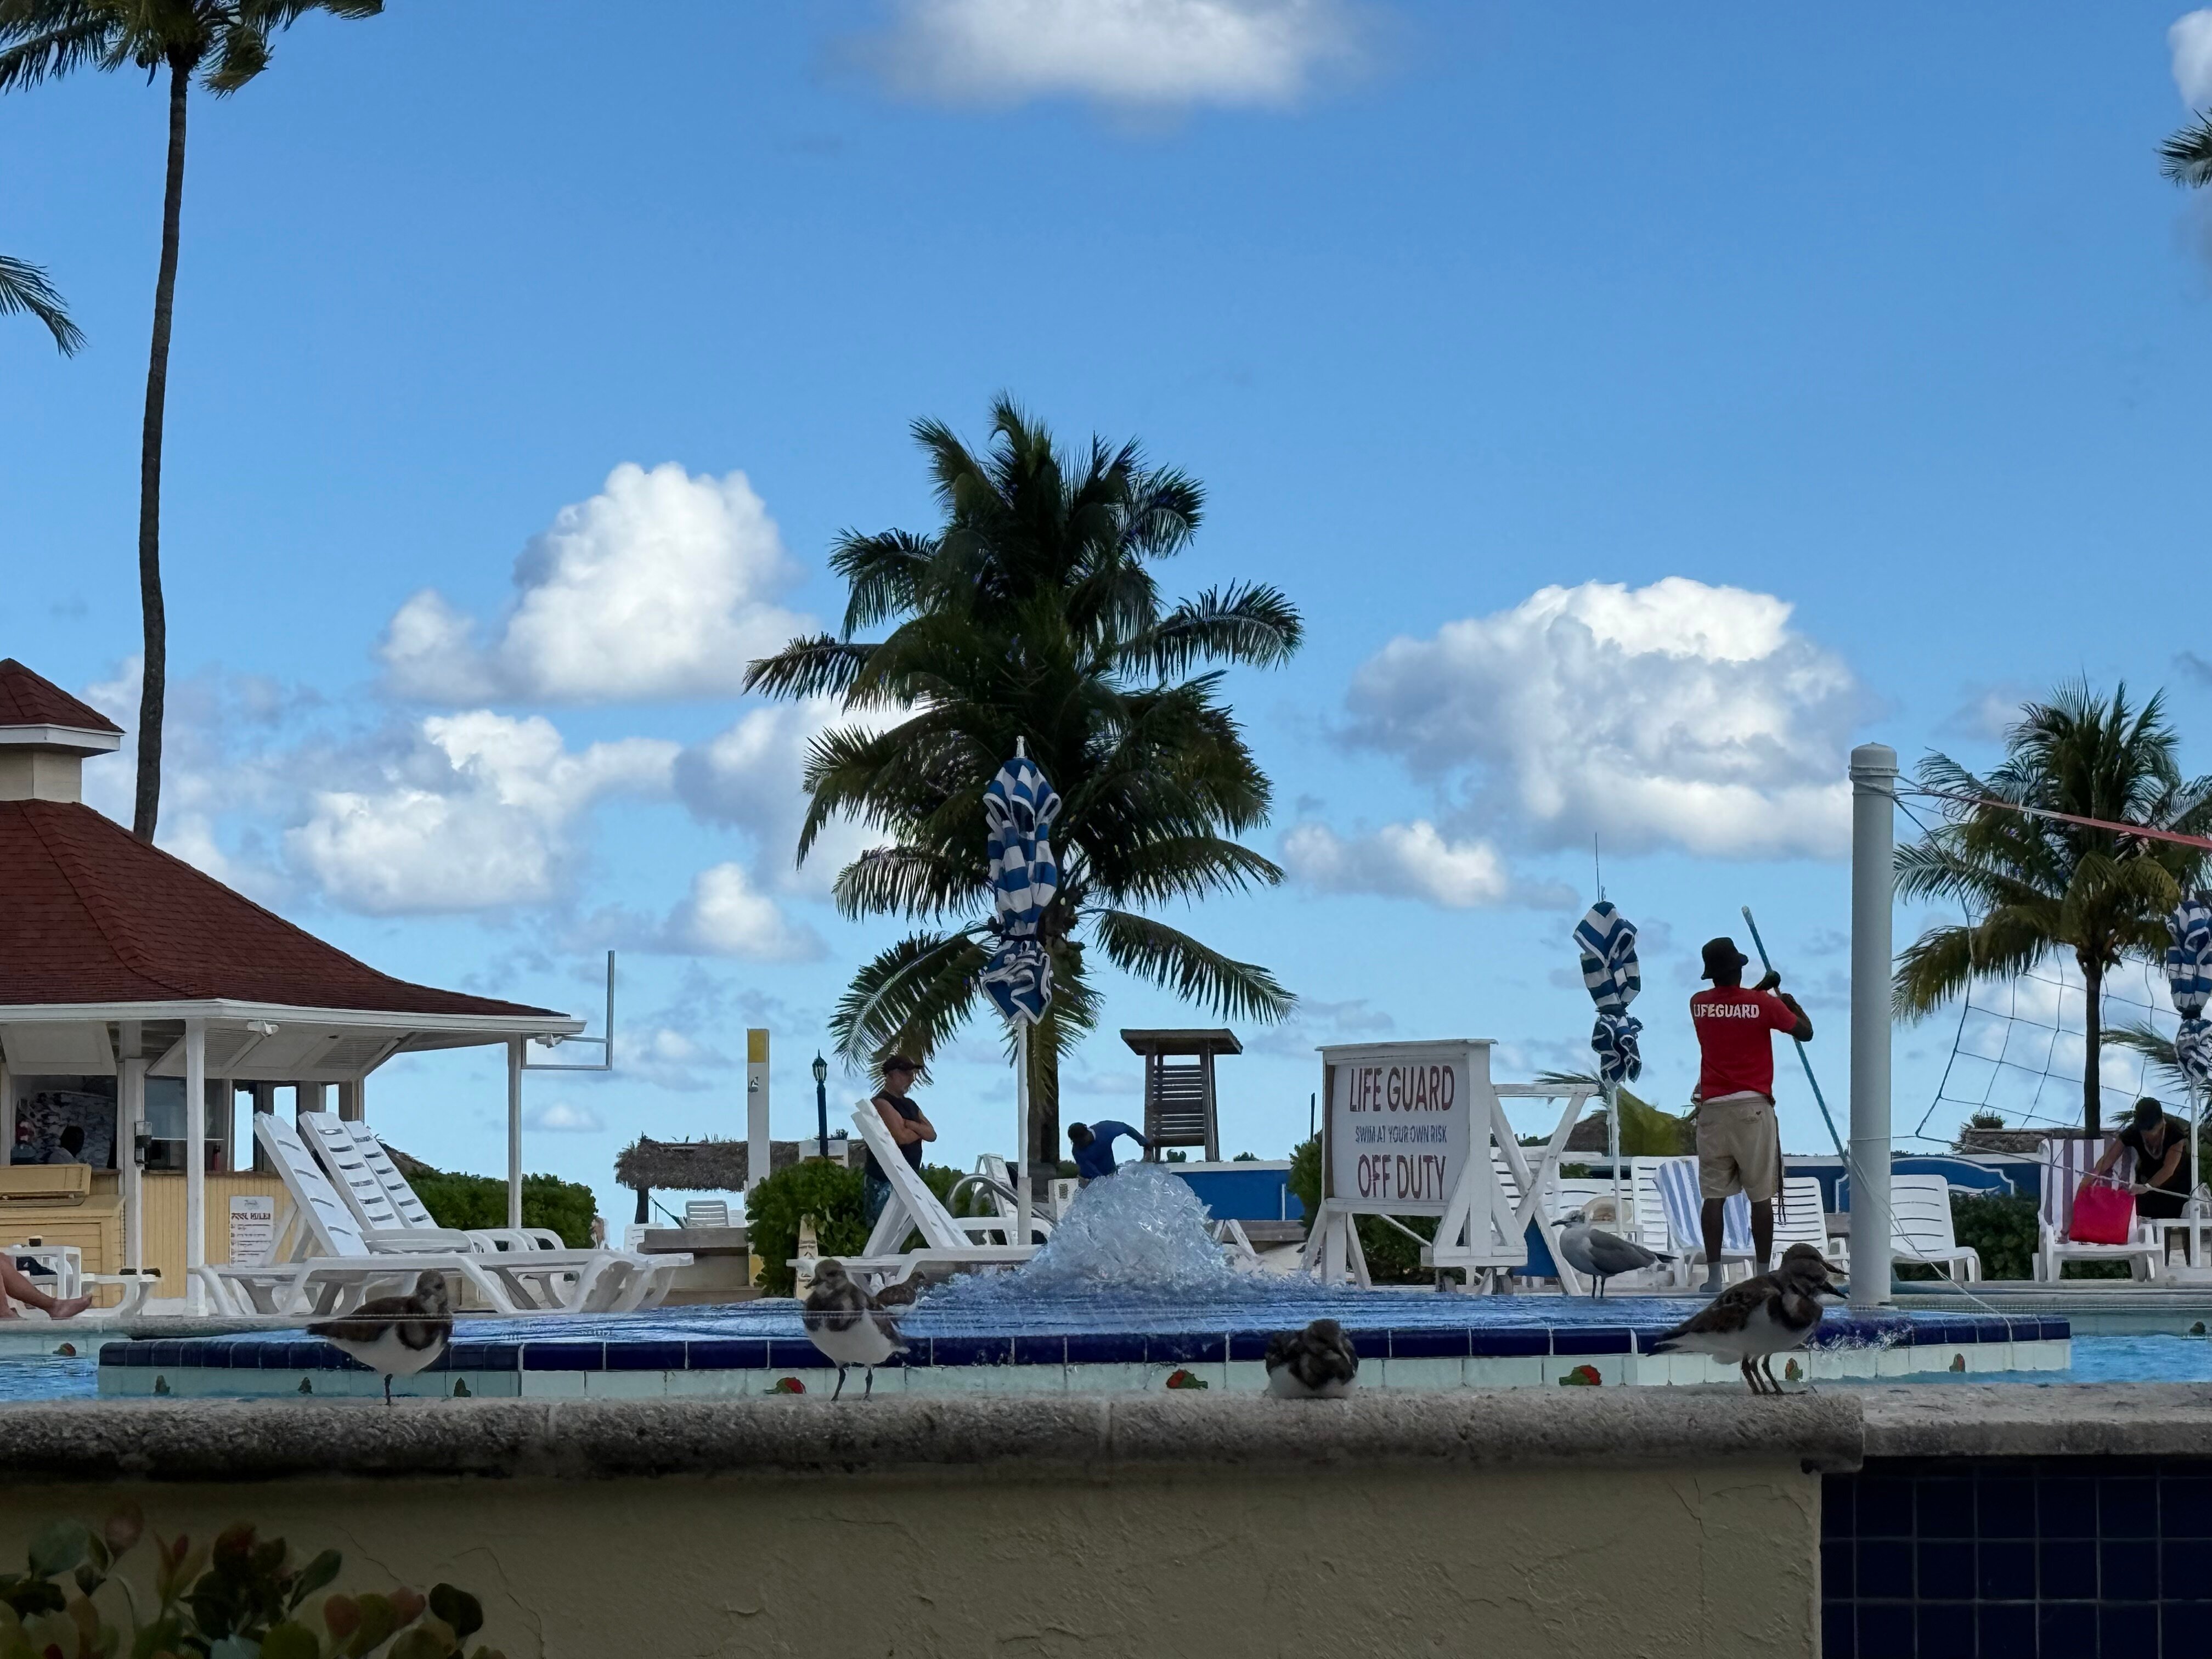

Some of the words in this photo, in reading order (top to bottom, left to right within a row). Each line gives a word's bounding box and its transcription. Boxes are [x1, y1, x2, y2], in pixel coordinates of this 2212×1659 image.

[1694, 1003, 1760, 1019] LIFEGUARD
[1350, 1067, 1383, 1111] LIFE
[1387, 1065, 1455, 1111] GUARD
[1355, 1125, 1375, 1143] SWIM
[1377, 1125, 1386, 1143] AT
[1388, 1125, 1408, 1143] YOUR
[1410, 1125, 1429, 1143] OWN
[1431, 1125, 1447, 1143] RISK
[1357, 1154, 1391, 1198] OFF
[1397, 1154, 1446, 1200] DUTY
